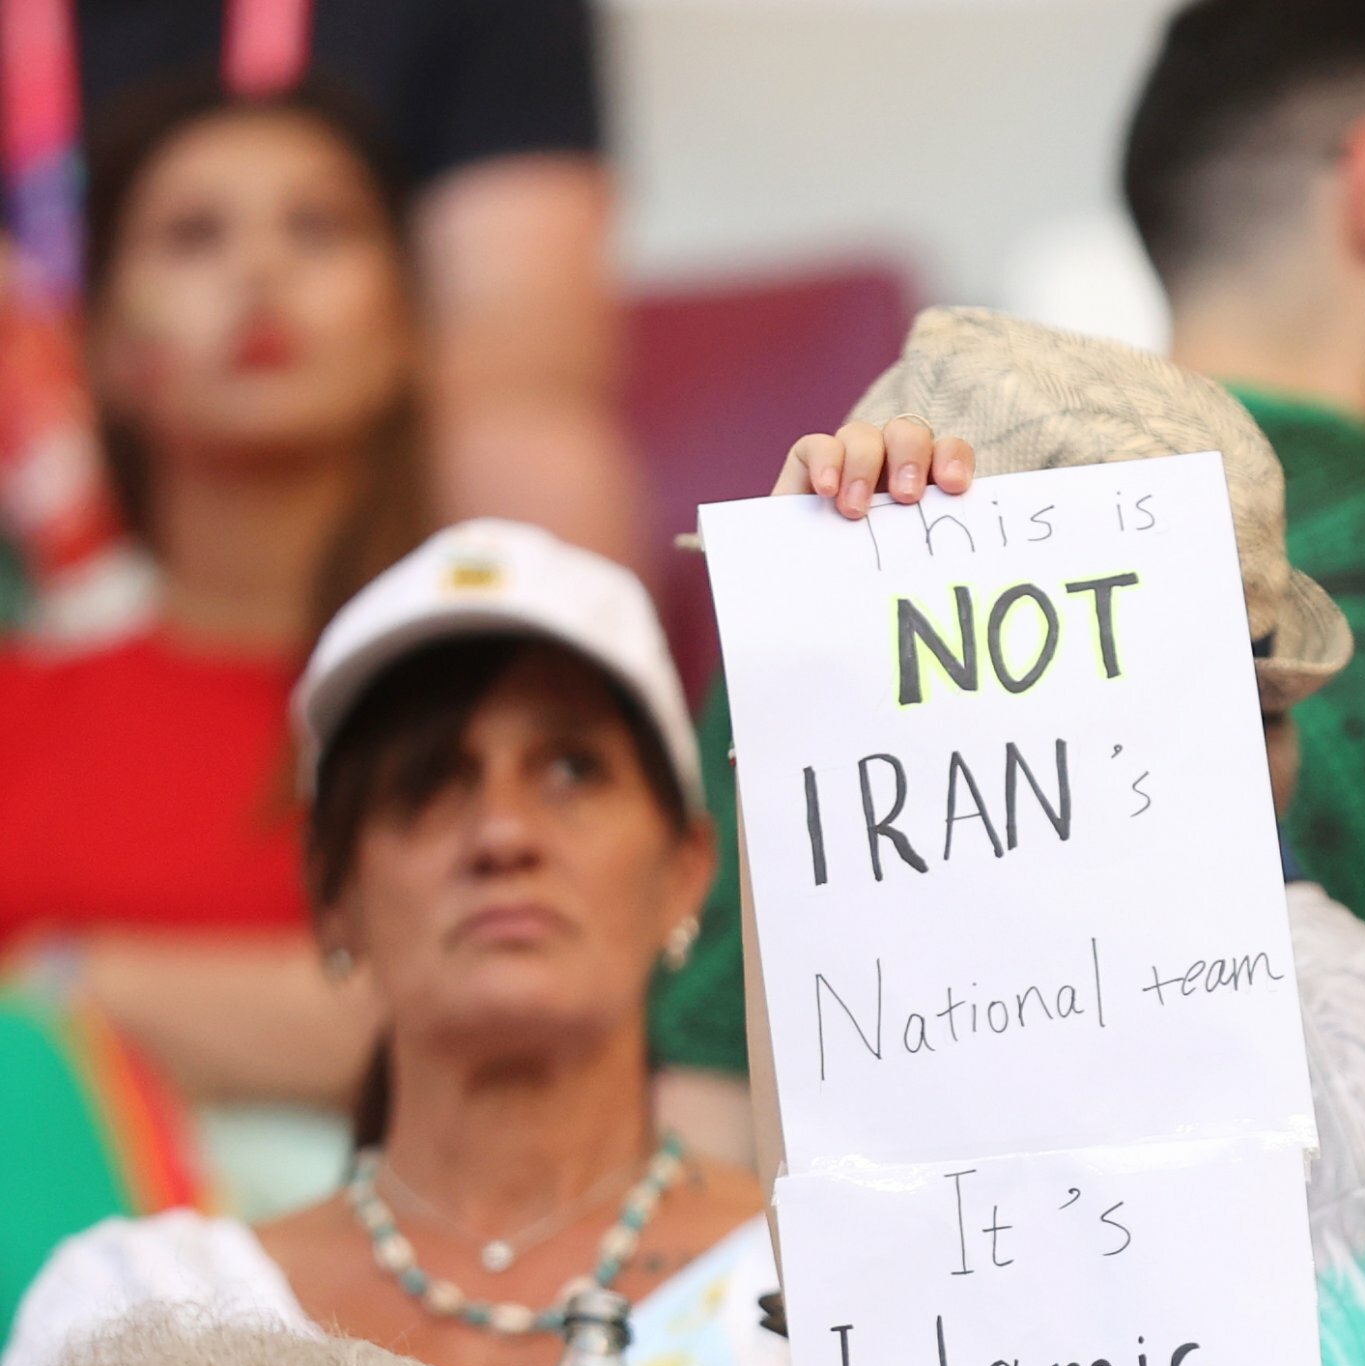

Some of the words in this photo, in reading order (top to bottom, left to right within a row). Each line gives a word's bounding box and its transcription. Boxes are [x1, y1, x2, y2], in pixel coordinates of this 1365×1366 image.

[861, 492, 1055, 571] This
[1116, 491, 1156, 532] is
[896, 571, 1140, 706] NOT
[802, 737, 1153, 887] IRAN's
[814, 936, 1107, 1082] National
[1141, 951, 1286, 1006] team
[943, 1168, 1133, 1276] It's
